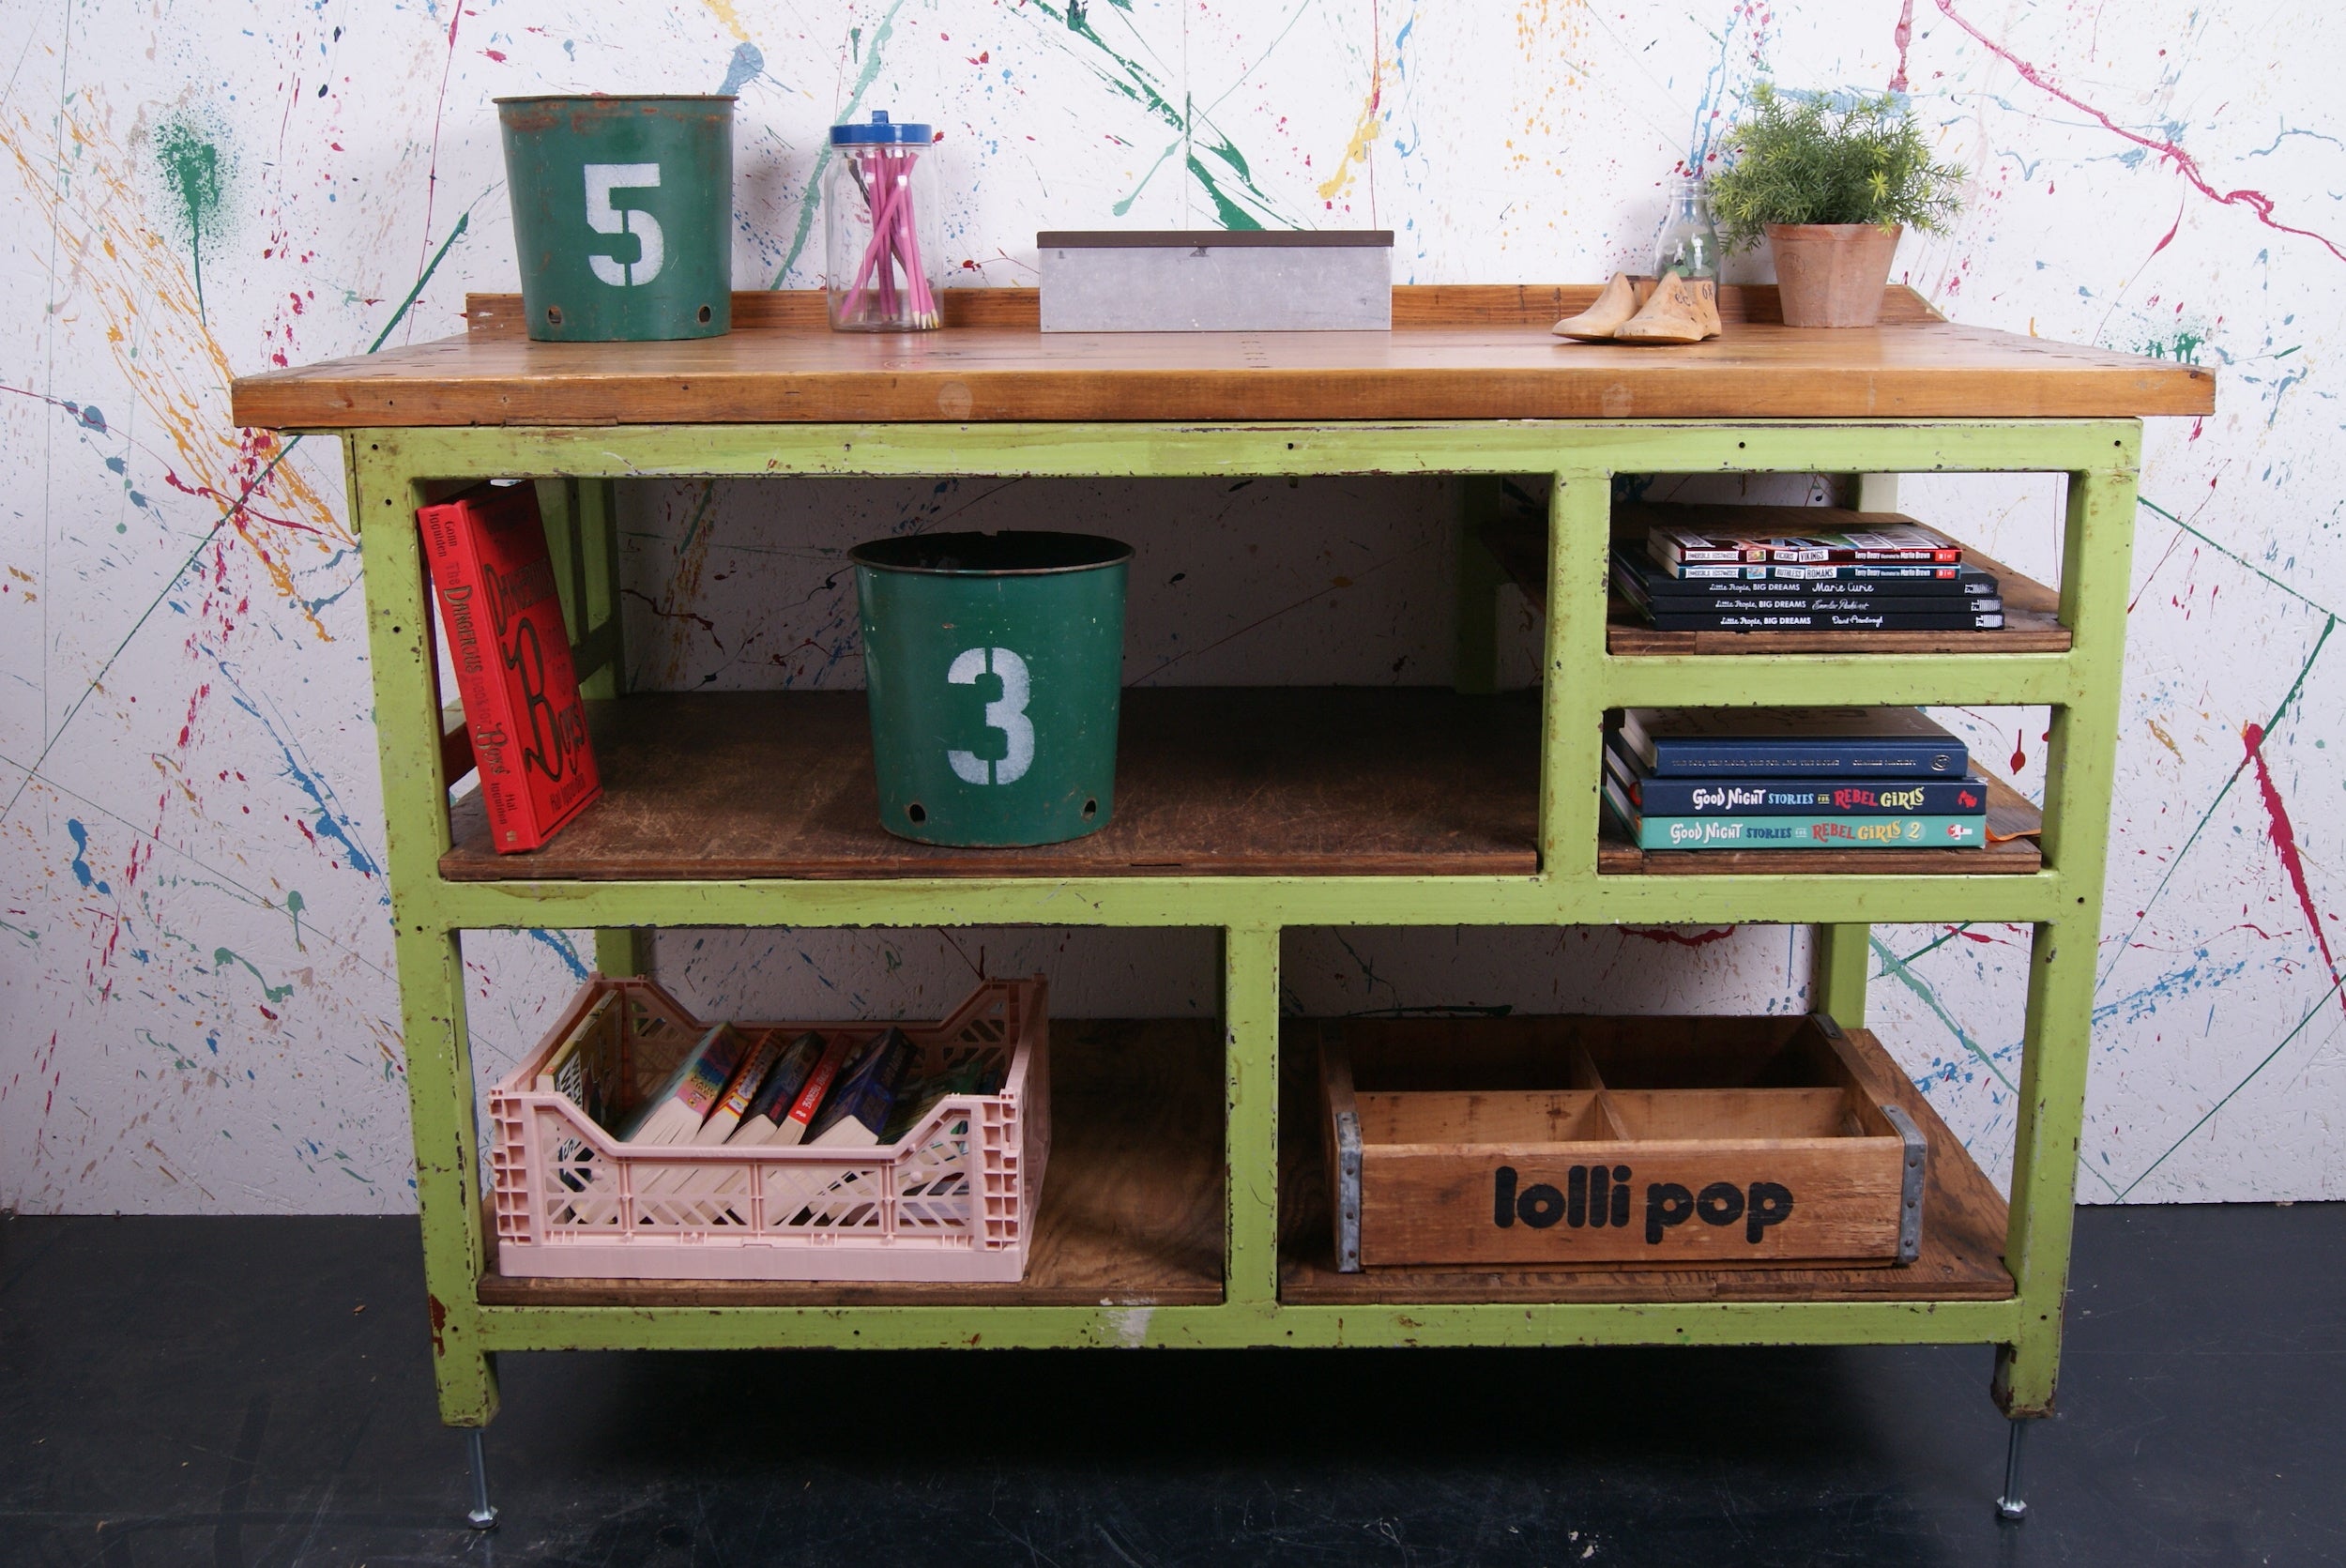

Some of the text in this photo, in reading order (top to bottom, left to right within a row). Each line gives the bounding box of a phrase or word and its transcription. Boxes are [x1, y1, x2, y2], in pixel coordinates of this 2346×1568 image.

[584, 162, 664, 287] 5
[1800, 551, 1824, 561] VIKINGS
[1806, 568, 1834, 578] ROMANS
[1811, 582, 1845, 593] Marie
[1847, 582, 1874, 593] Curie
[443, 585, 483, 675] DANGEROUS
[1763, 617, 1777, 625] BIG
[1779, 617, 1812, 625] DREAMS
[947, 647, 1035, 785] 3
[1768, 793, 1815, 805] STORIES
[1834, 788, 1879, 810] REBEL
[1745, 827, 1792, 839] STORIES
[1811, 822, 1856, 843] REBEL
[1910, 822, 1921, 840] 2
[1645, 1181, 1794, 1245] pop
